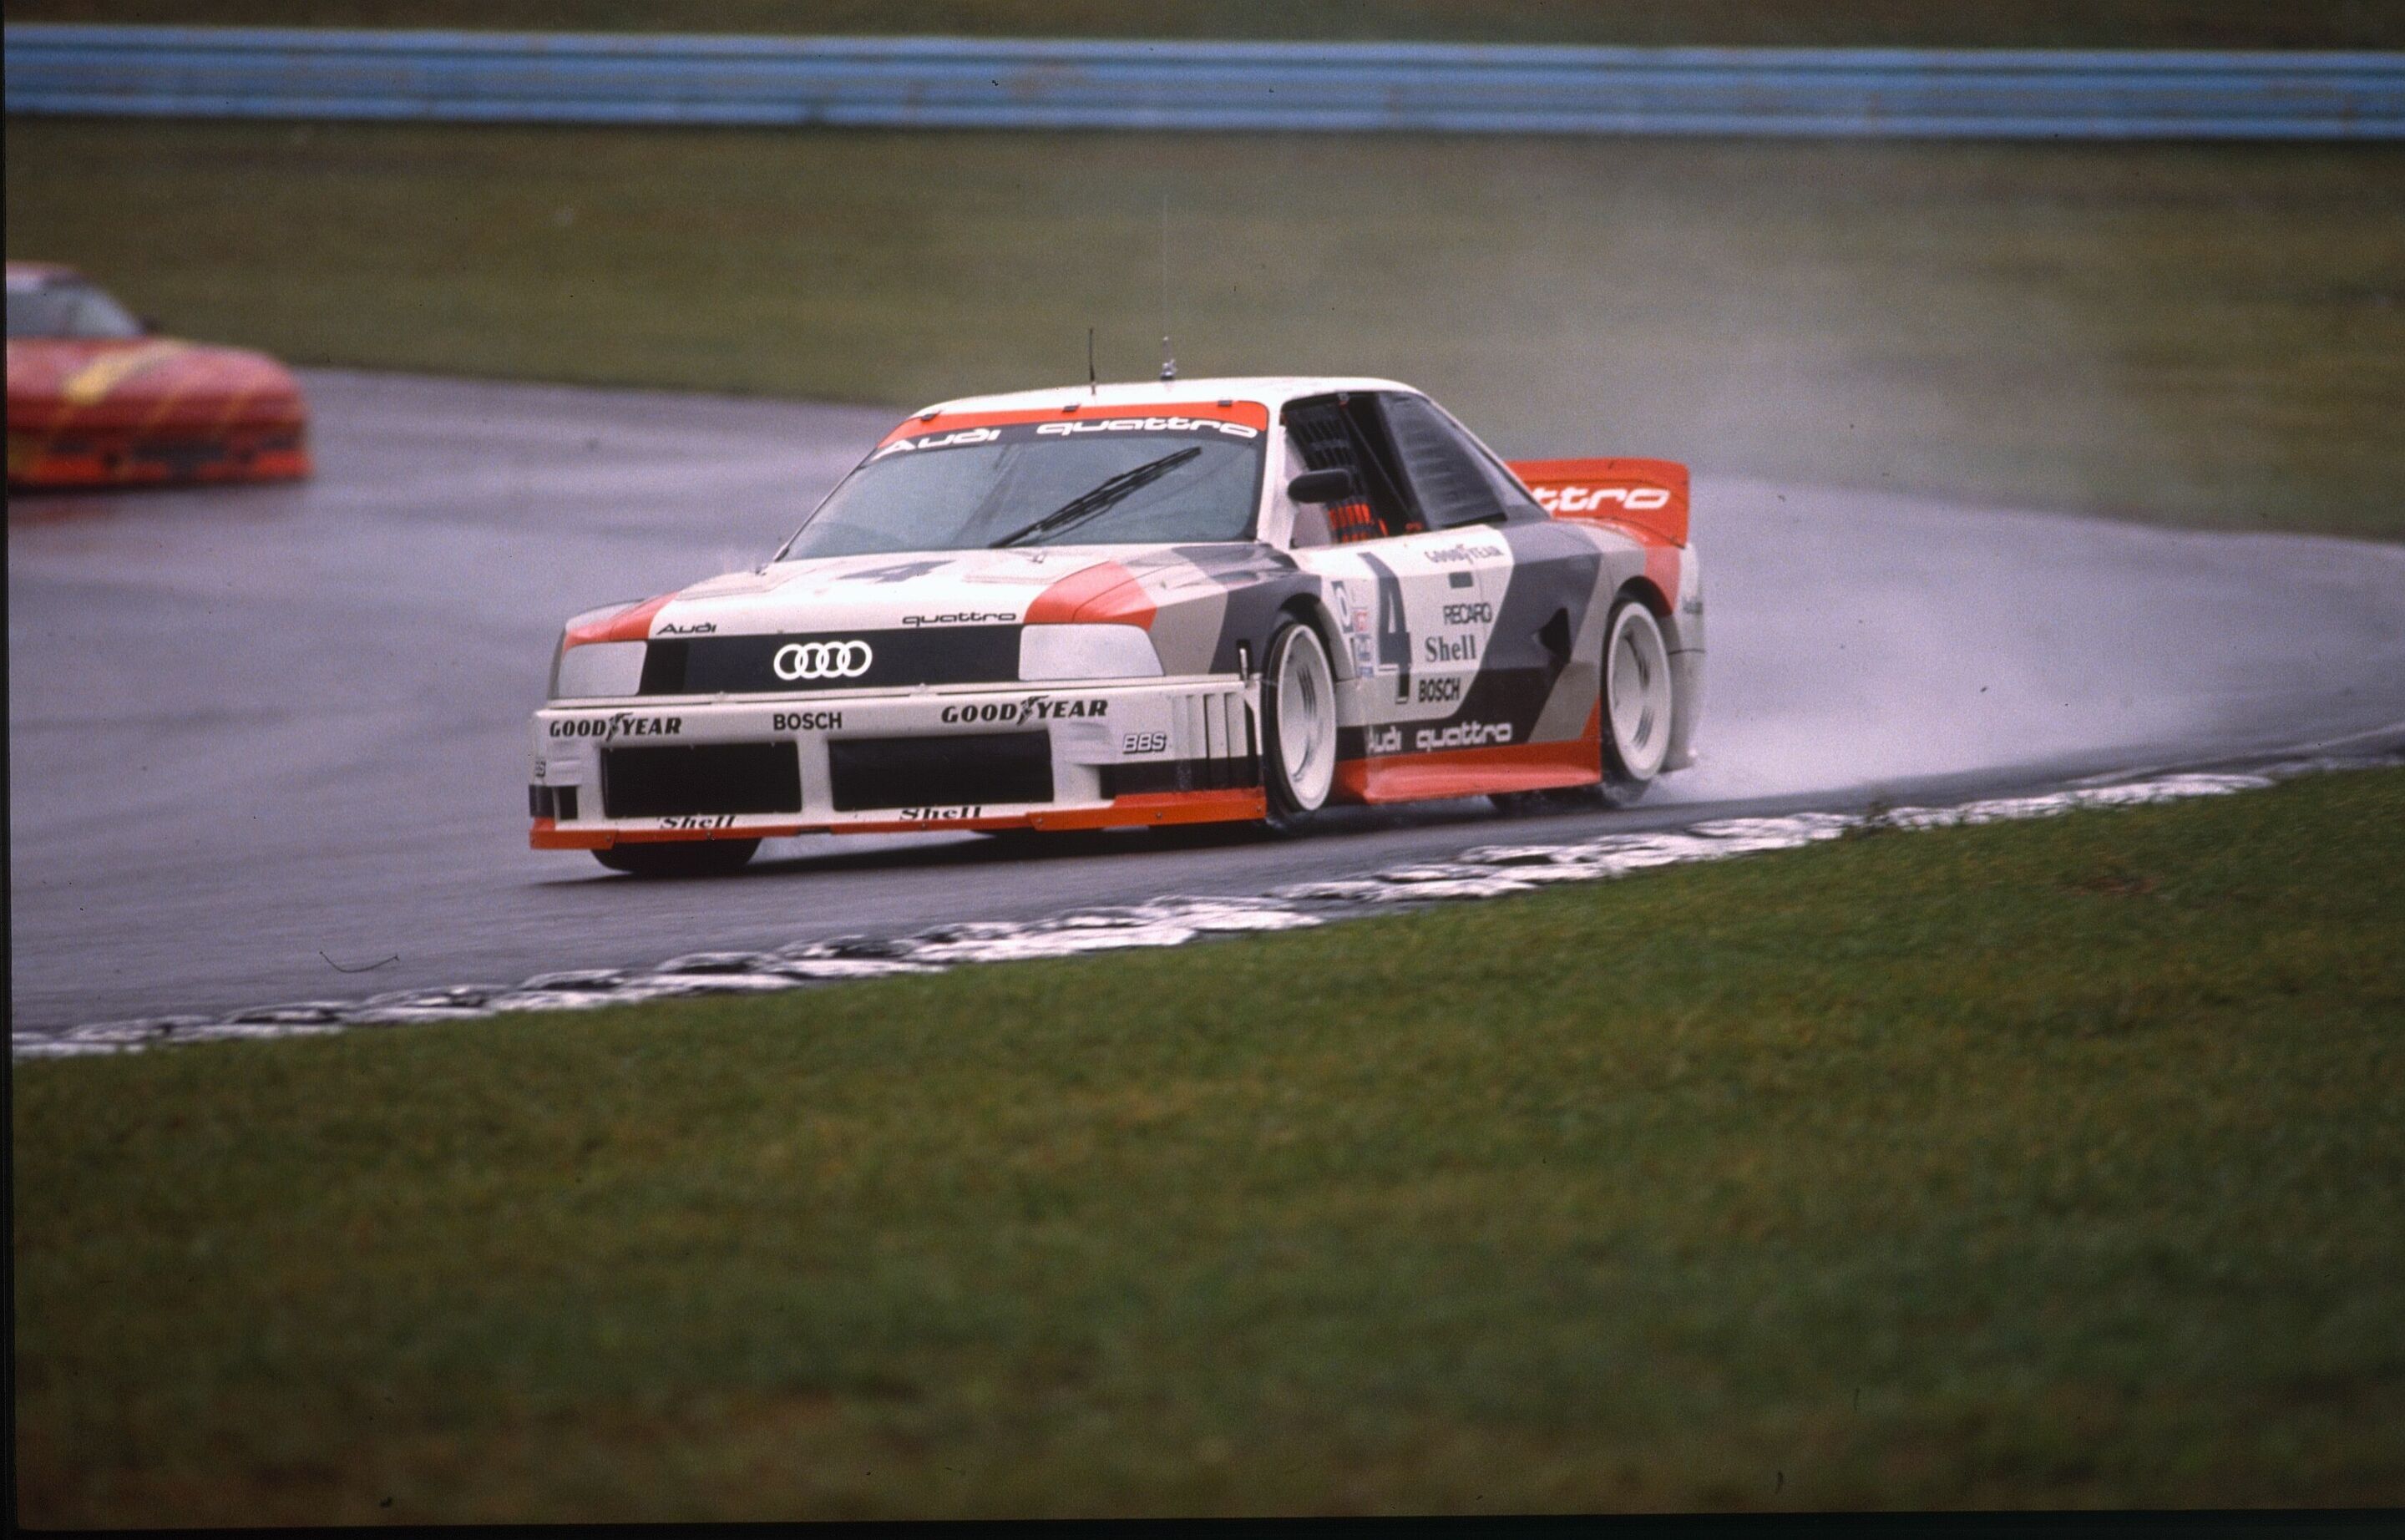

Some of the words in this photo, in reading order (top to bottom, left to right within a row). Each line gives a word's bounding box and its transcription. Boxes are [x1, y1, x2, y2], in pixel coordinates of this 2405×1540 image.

[872, 428, 1001, 460] Audi
[1036, 417, 1258, 438] quattro
[902, 610, 1017, 627] quattro
[1443, 602, 1492, 625] RECARO
[656, 623, 717, 635] Audi
[1357, 552, 1413, 704] 4
[1425, 634, 1476, 663] Shell
[1419, 678, 1461, 703] BOSCH
[772, 712, 843, 730] BOSCH
[1122, 732, 1167, 753] BBS
[1415, 721, 1513, 752] quattro
[660, 815, 737, 830] Shell
[899, 805, 981, 821] Shell
